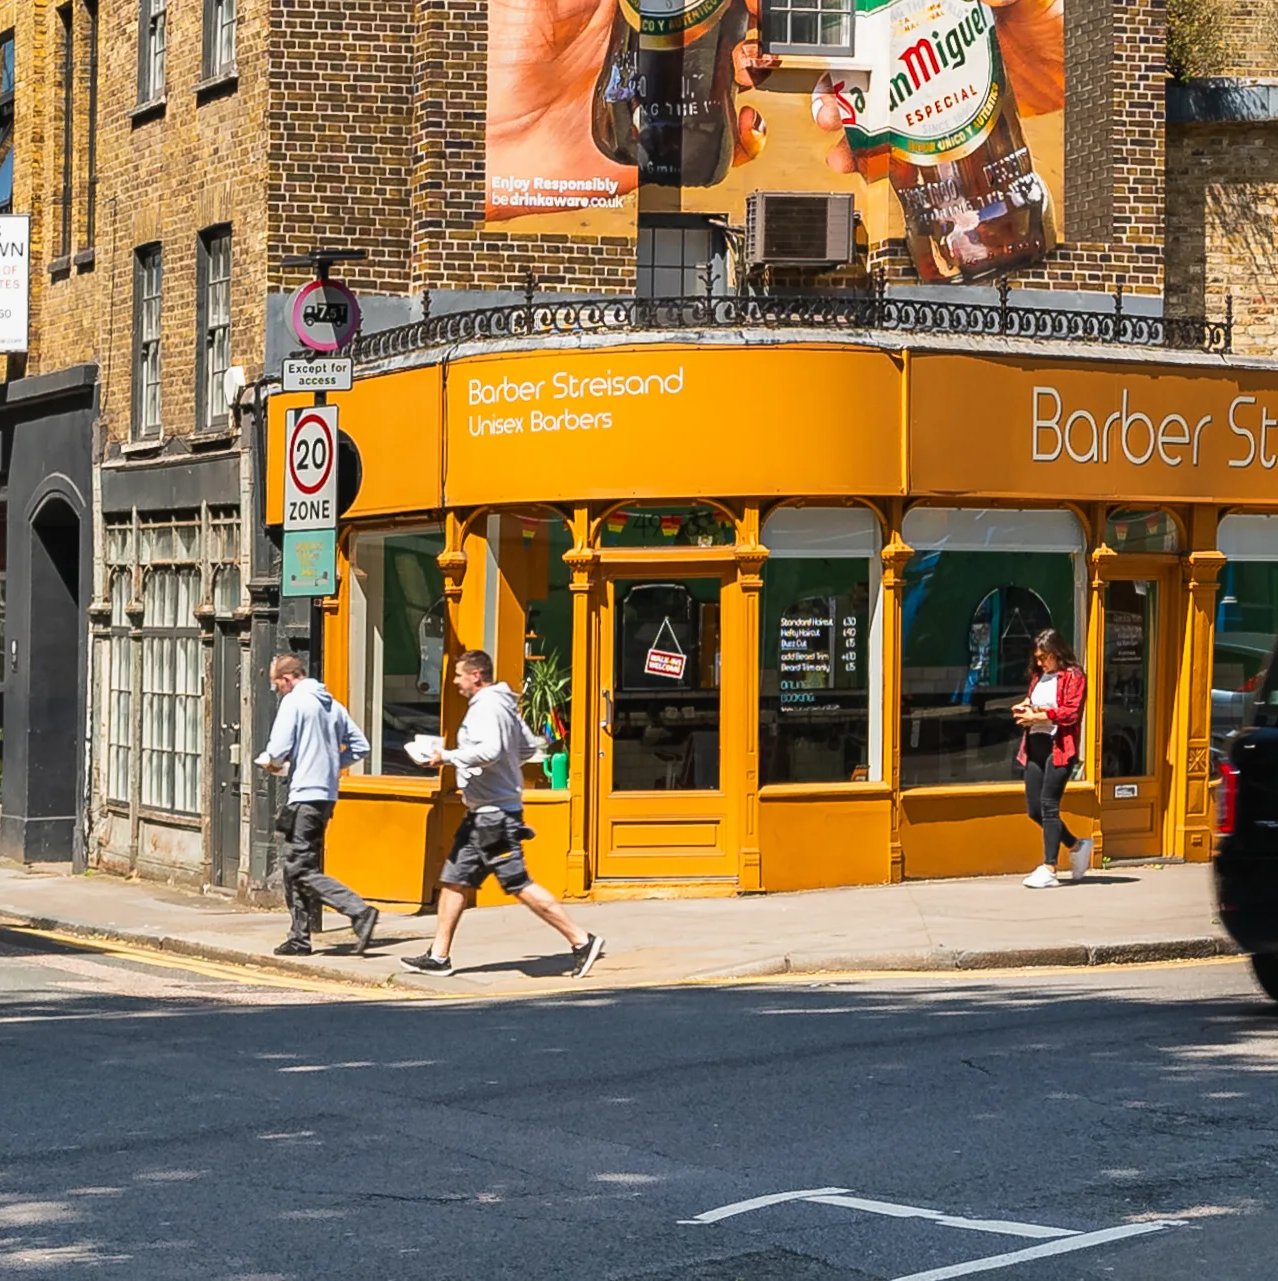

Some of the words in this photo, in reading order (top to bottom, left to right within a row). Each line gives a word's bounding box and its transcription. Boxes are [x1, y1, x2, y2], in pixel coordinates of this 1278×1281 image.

[906, 84, 979, 128] ESPECIAL
[491, 175, 531, 192] Enjoy
[533, 176, 619, 194] Responsibly
[509, 192, 624, 209] drinkaware.co.uk
[2, 265, 18, 276] OF
[288, 363, 328, 375] Except
[331, 363, 348, 373] for
[298, 376, 337, 386] access
[468, 375, 546, 406] Barber
[552, 366, 684, 400] Streisand
[468, 413, 524, 437] Unisex
[530, 407, 613, 432] Barbers
[1032, 385, 1213, 466] Barber
[296, 437, 327, 471] 20
[289, 499, 331, 521] ZONE
[780, 617, 812, 627] Standard
